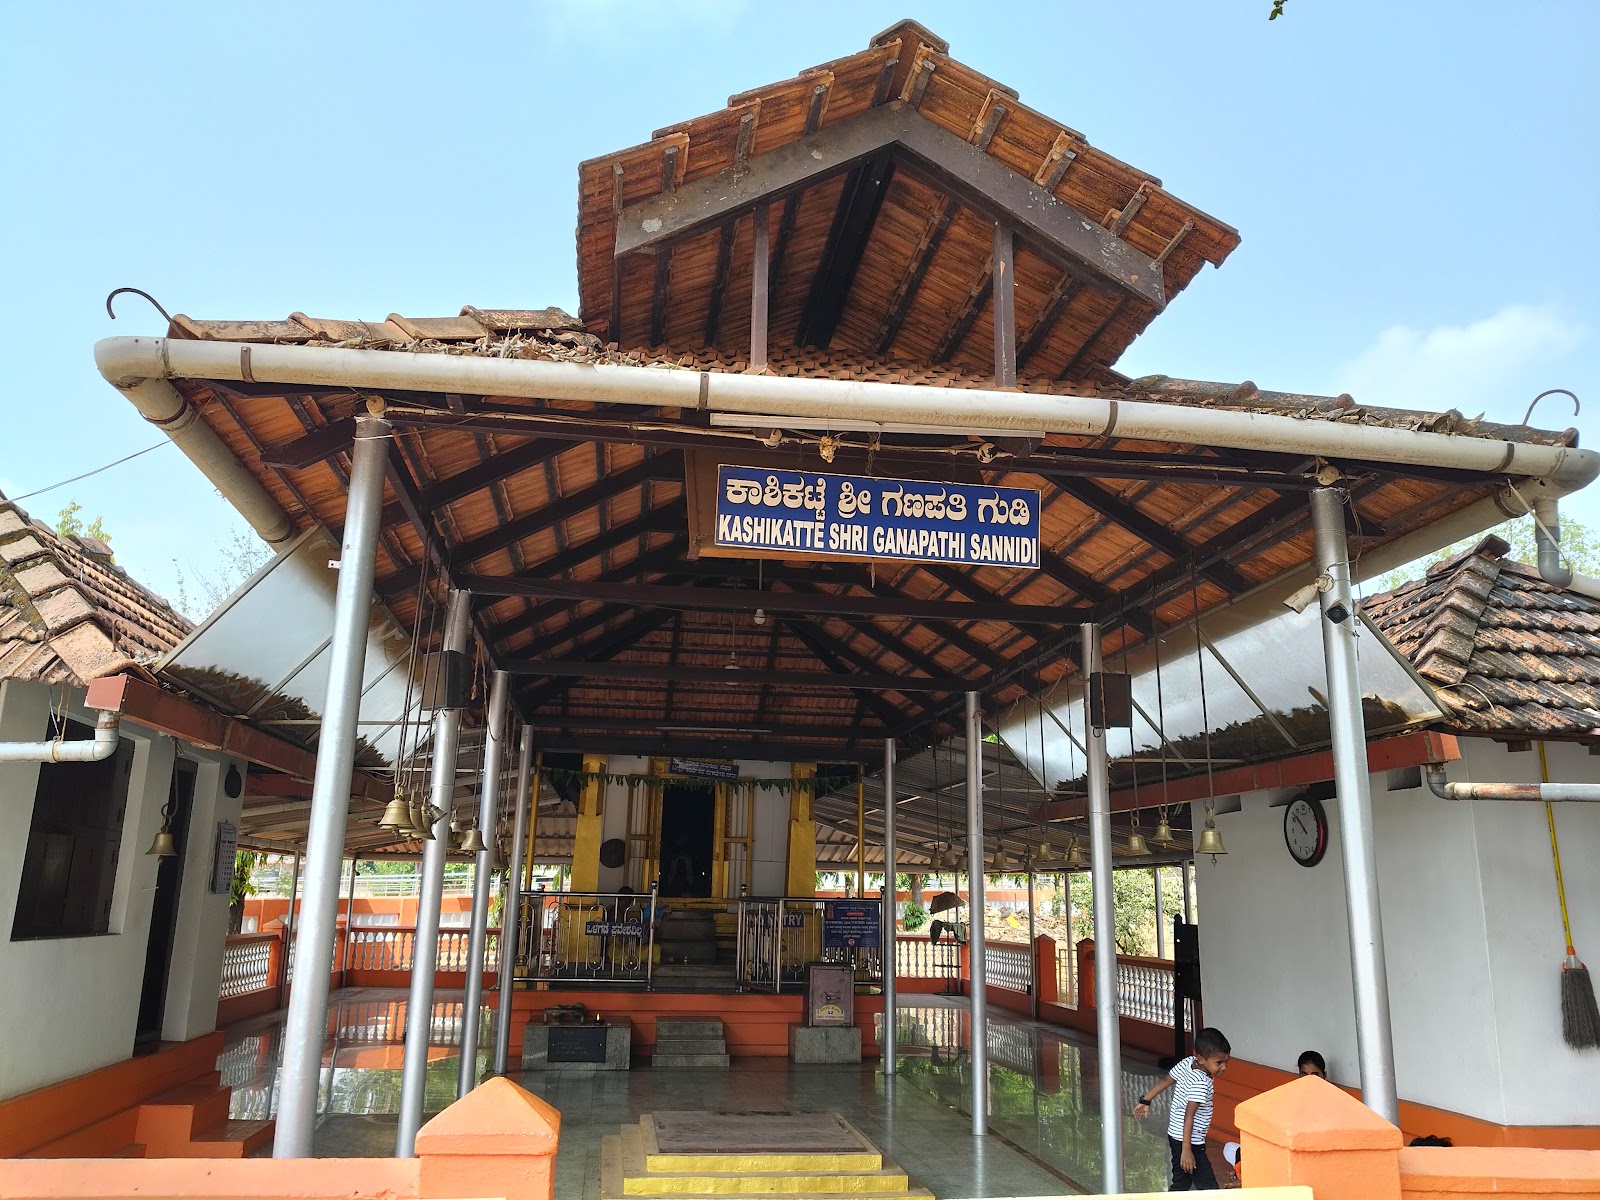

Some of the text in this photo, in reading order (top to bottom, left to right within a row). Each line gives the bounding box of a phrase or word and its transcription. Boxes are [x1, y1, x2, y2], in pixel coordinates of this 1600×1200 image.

[726, 475, 1030, 525] ಕಾಶಿಕಟ್ಟೆ ಶ್ರೀ ಗಣಪತಿ ಗುಡಿ
[719, 514, 1036, 563] KASHIKATTE SHRI GANAPATHI SANNIDI
